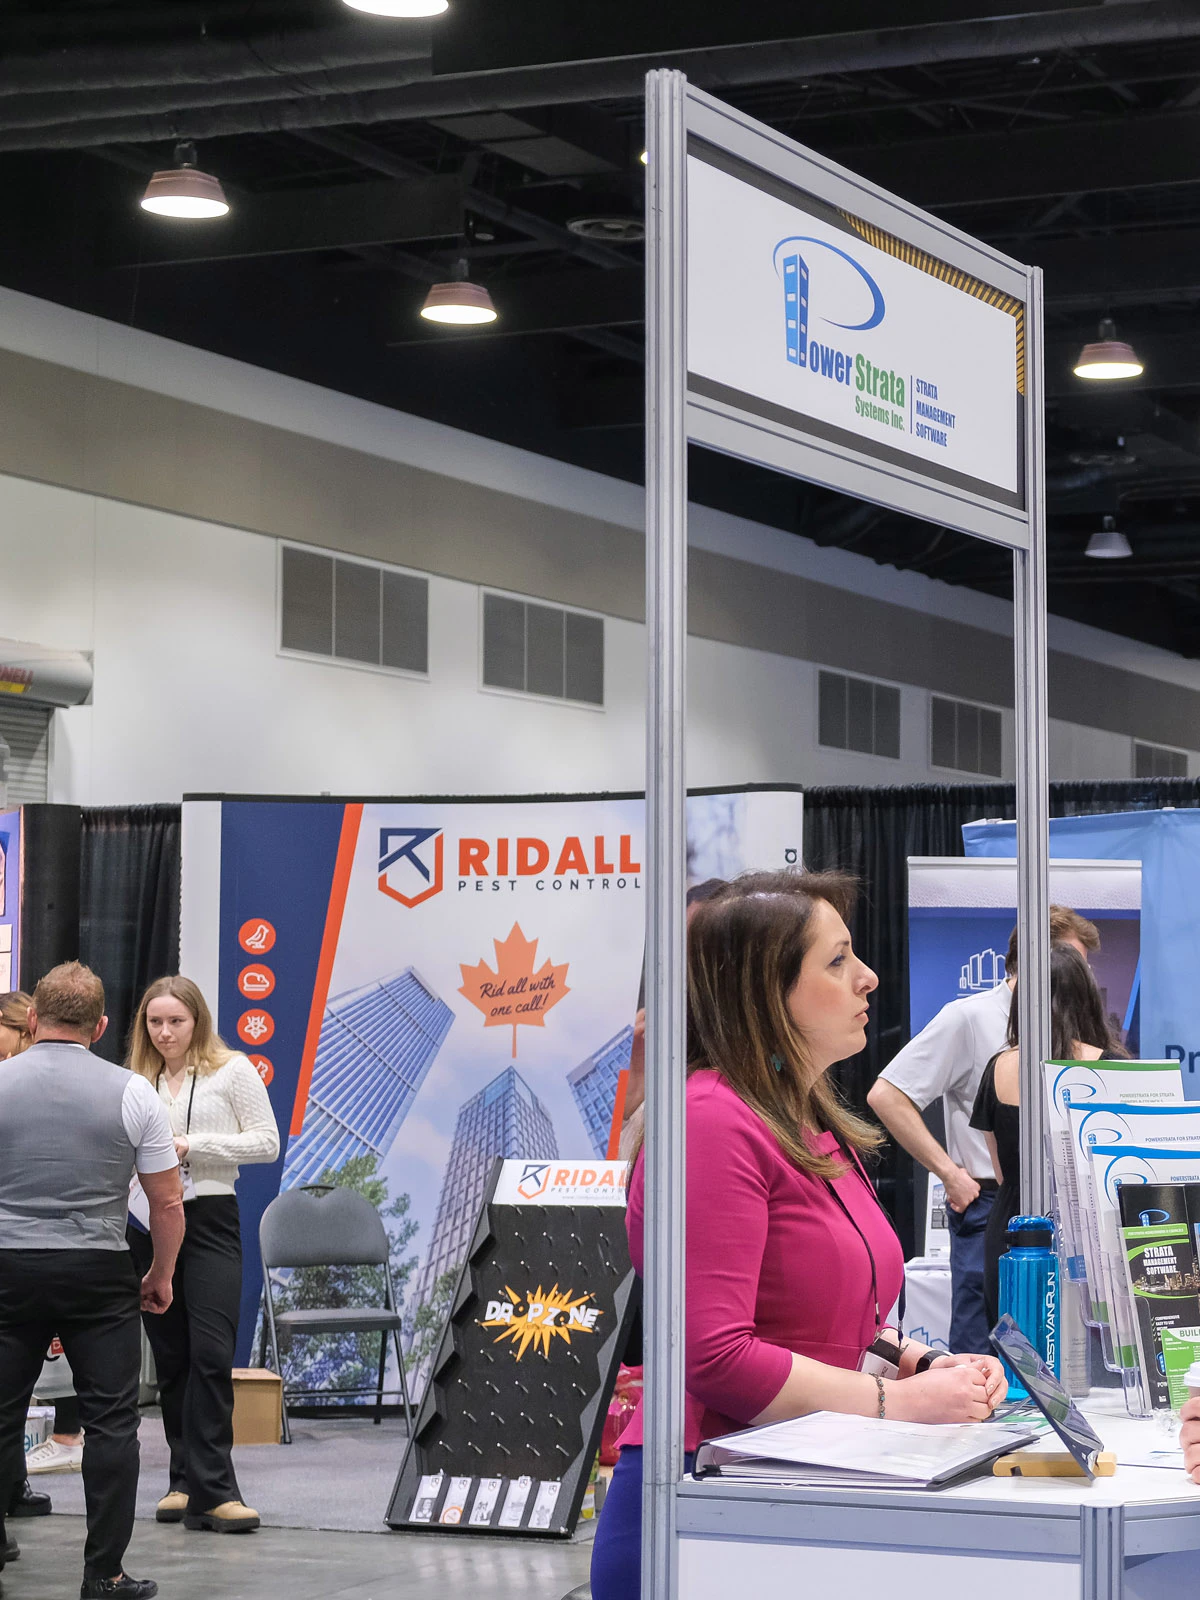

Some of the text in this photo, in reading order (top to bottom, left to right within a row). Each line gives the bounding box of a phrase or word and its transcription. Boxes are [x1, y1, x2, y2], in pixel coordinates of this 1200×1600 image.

[855, 353, 905, 408] Strata
[916, 378, 938, 400] STRATA
[855, 395, 905, 431] Systems Inc.
[916, 400, 956, 429] MANAGEMENT
[916, 422, 947, 447] SOFTWARE
[458, 835, 641, 877] RIDALL
[458, 877, 641, 892] PEST CONTROL
[480, 973, 555, 999] Rid all with
[490, 993, 549, 1017] one call!
[554, 1169, 627, 1187] RIDAL
[1143, 1257, 1177, 1266] MANAGEMENT
[1144, 1246, 1174, 1258] STRATA
[485, 1300, 600, 1328] DROP ZONE
